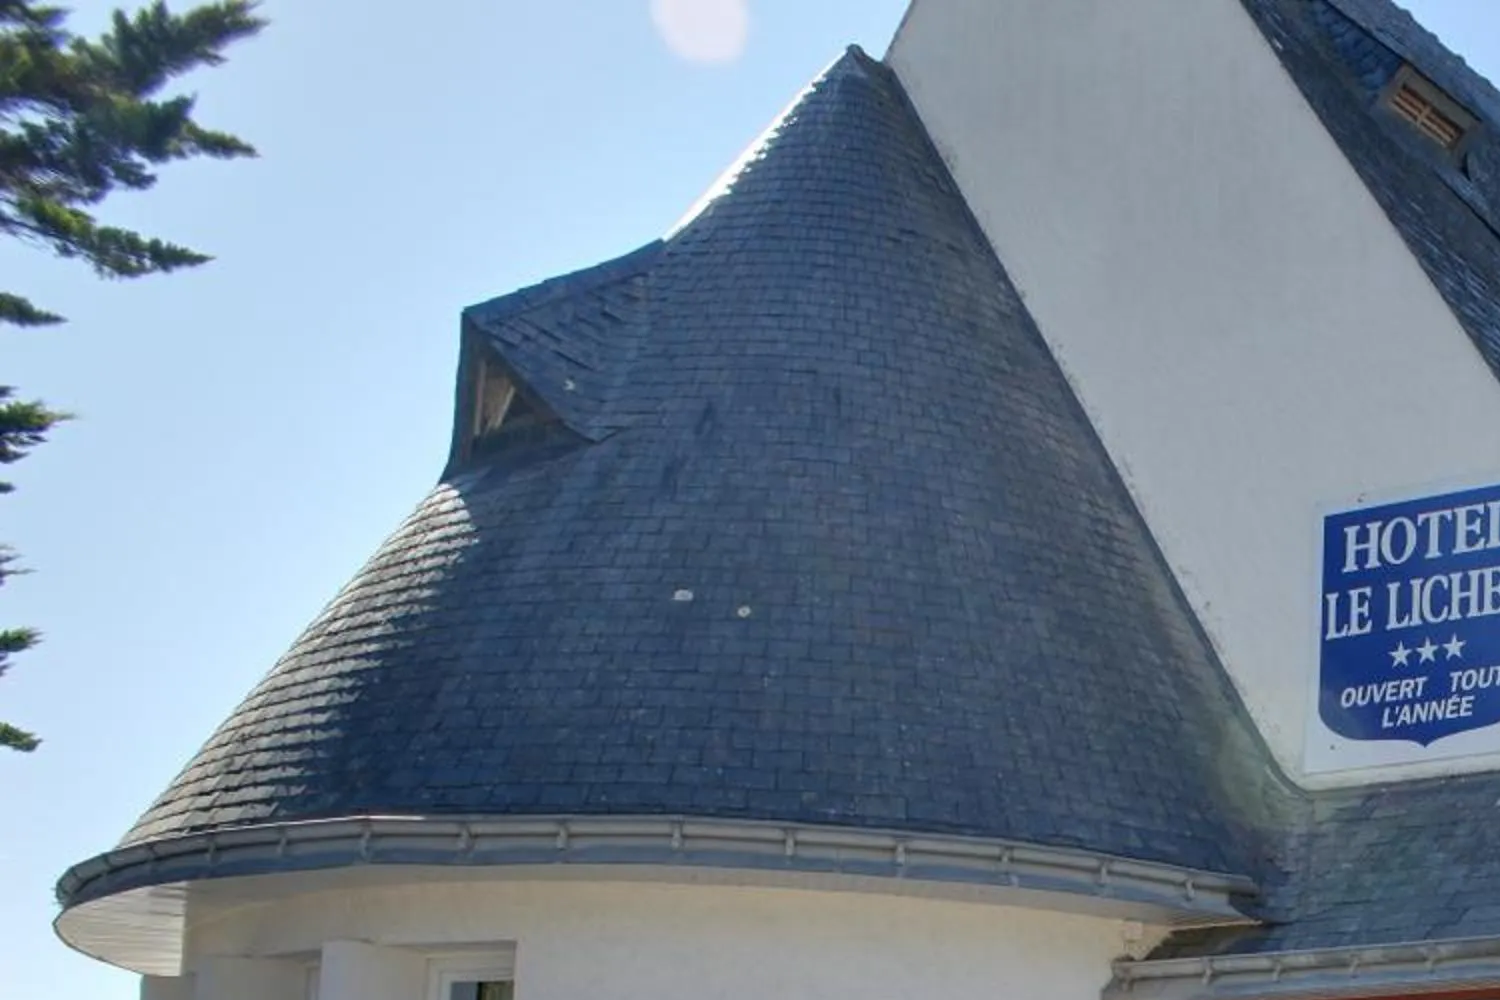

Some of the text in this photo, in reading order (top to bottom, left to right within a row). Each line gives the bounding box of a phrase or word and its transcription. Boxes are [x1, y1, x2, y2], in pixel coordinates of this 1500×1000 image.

[1325, 586, 1373, 640] LE
[1341, 677, 1427, 708] OUVERT
[1382, 694, 1474, 728] L'ANNÉE
